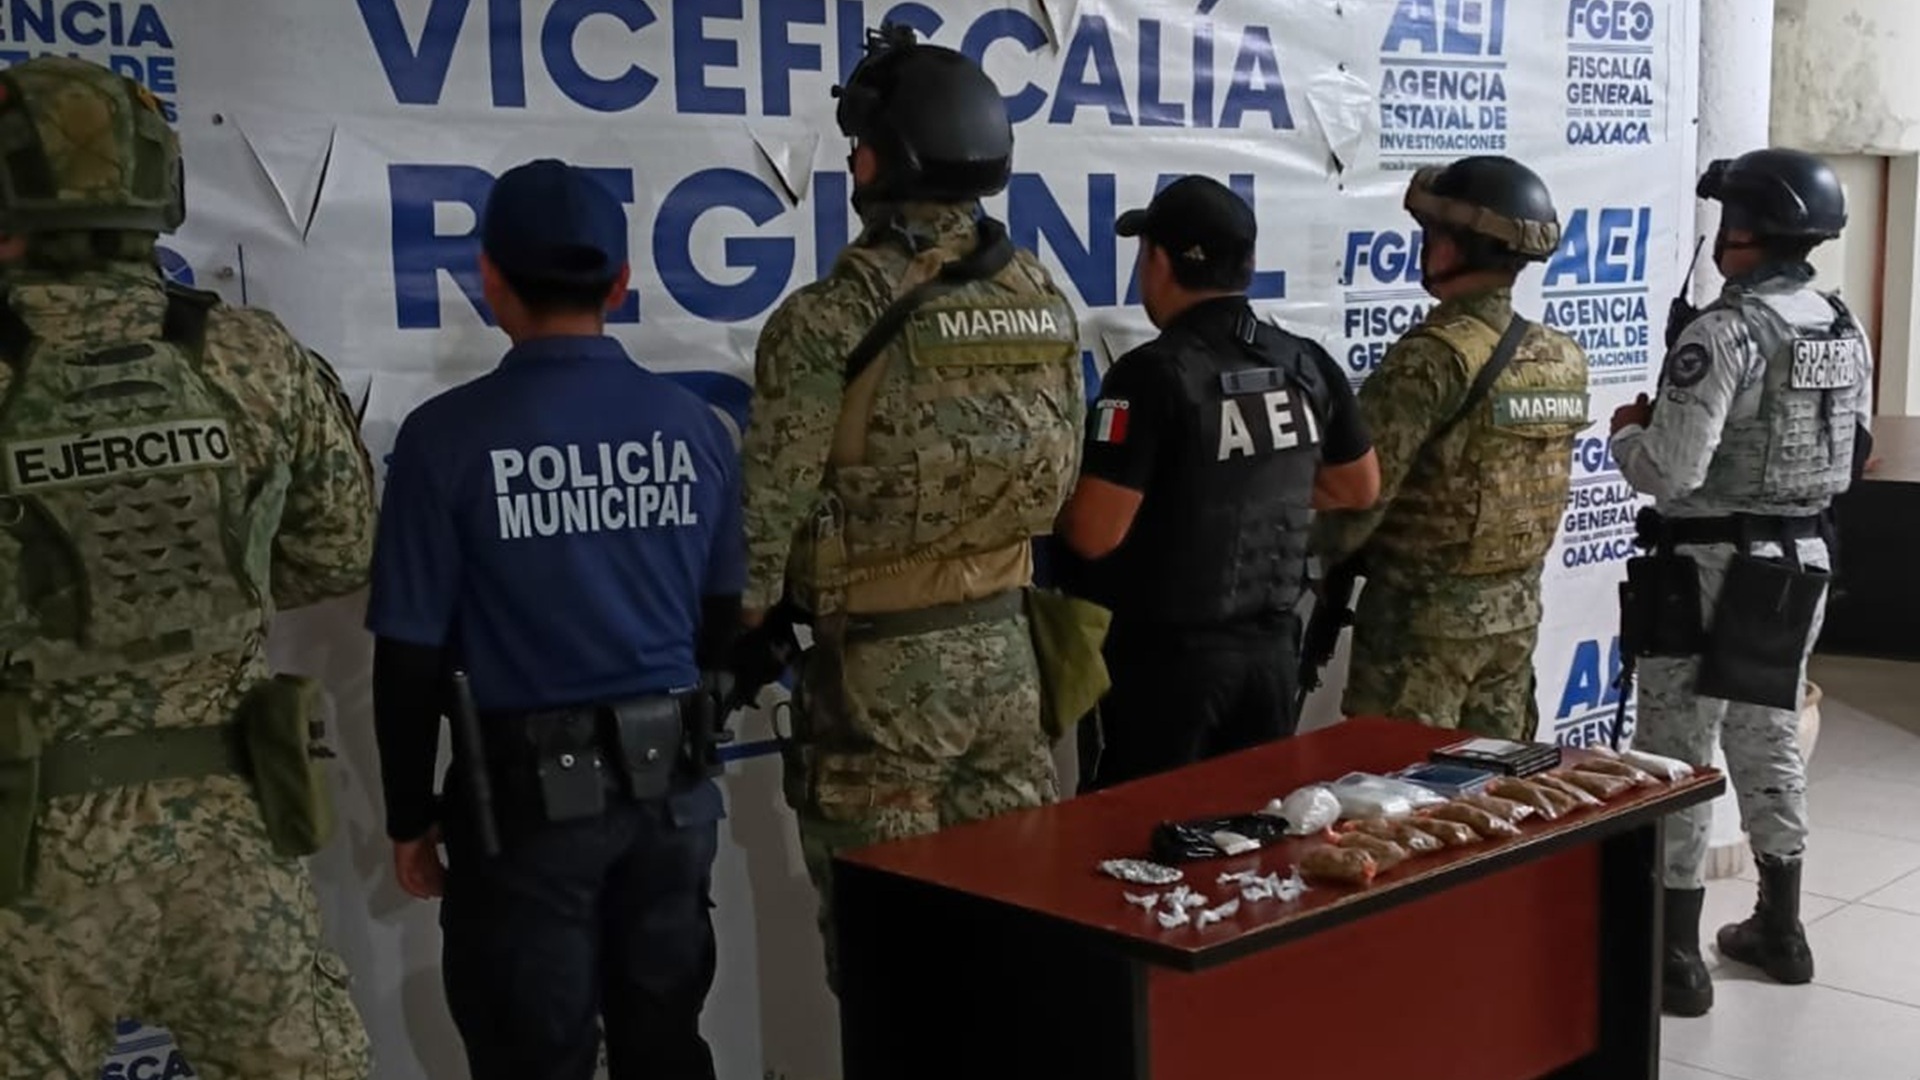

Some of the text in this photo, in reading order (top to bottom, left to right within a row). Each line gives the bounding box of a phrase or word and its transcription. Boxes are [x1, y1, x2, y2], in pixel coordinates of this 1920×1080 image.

[1567, 0, 1654, 41] FGEO
[357, 0, 1295, 129] VICEFICALÍA
[1567, 55, 1652, 80] FISCALÍA
[1380, 68, 1507, 101] AGENCIA
[1567, 83, 1653, 105] GENERAL
[1380, 103, 1507, 130] ESTATAL DE
[1380, 133, 1506, 150] INVESTIGACIONES
[1566, 121, 1652, 145] OAXACA
[1542, 207, 1651, 286] AEI
[937, 308, 1058, 338] MARINA
[1543, 298, 1648, 327] AGENCIA
[1624, 326, 1648, 346] DE
[1509, 397, 1584, 419] MARINA
[14, 426, 230, 485] EJÉRCITO
[490, 430, 698, 494] POLICÍA
[497, 483, 698, 539] MUNICIPAL
